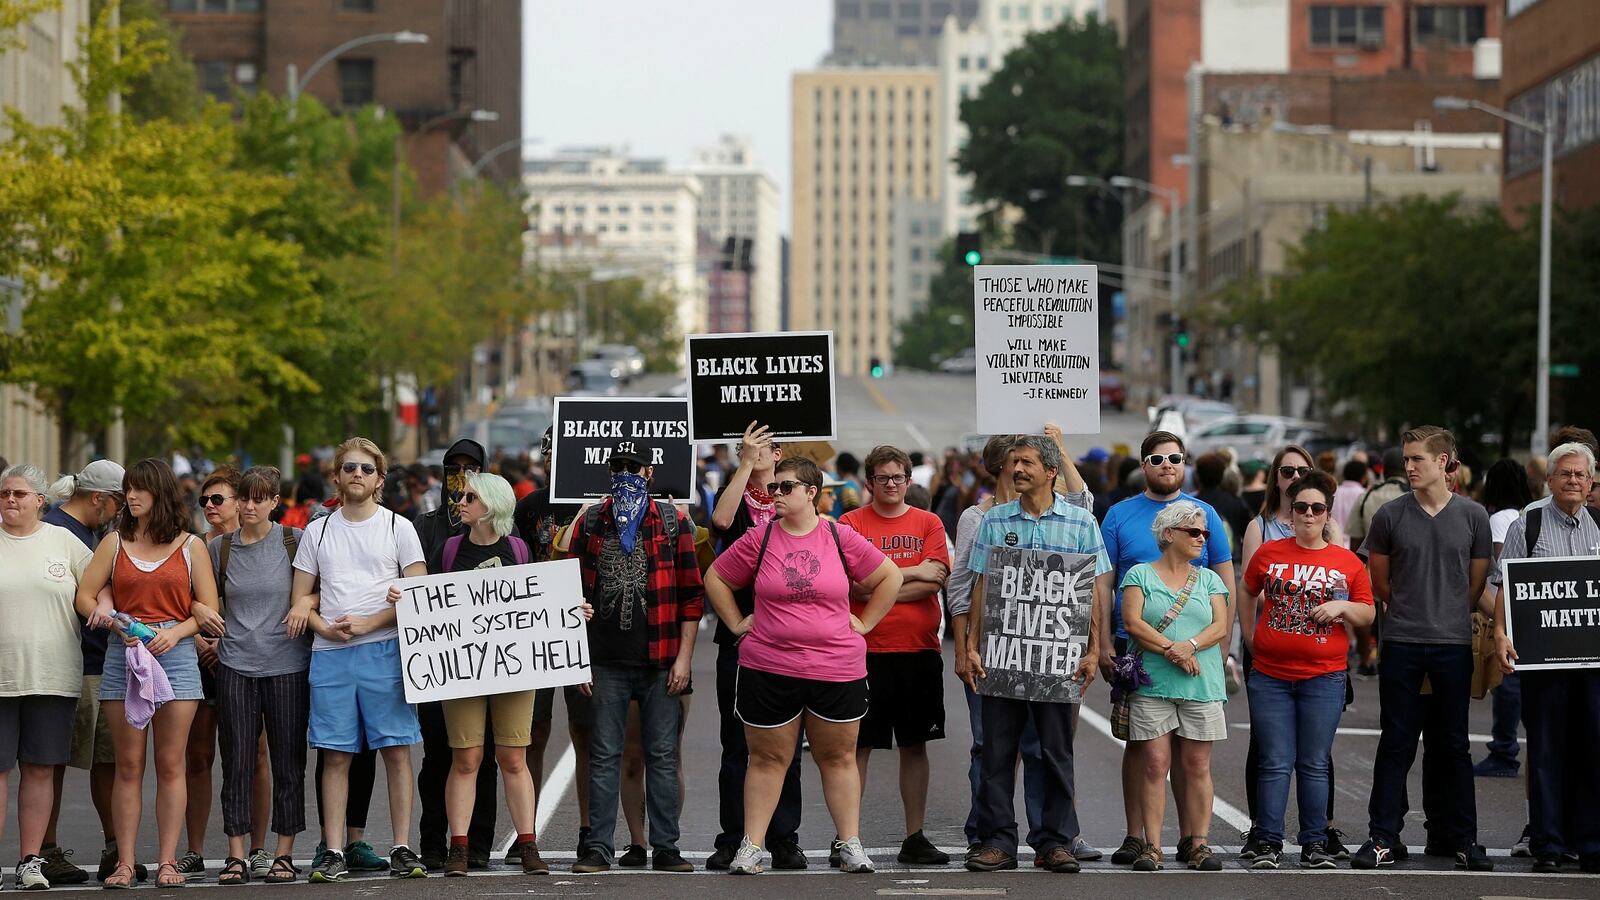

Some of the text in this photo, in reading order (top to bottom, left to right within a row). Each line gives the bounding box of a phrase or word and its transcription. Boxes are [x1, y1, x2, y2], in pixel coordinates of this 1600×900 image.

[979, 278, 1089, 294] THOSE WHO MAKE
[983, 298, 1093, 313] PEACEFUL REVOLUTION
[1008, 314, 1064, 329] IMPOSSIBLE
[1007, 339, 1067, 352] WILL MAKE
[696, 355, 824, 376] BLACK LIVES
[986, 354, 1090, 370] VIOLENT REVOLUTION
[1001, 371, 1064, 385] INEVITABLE
[720, 384, 802, 404] MATTER
[1045, 388, 1089, 400] KENNEDY
[563, 420, 687, 438] BLACK LIVES
[584, 447, 664, 465] MAR
[1266, 563, 1342, 584] IT WAS
[403, 575, 545, 615] THE WHOLE
[1001, 565, 1082, 605] BLACK
[1514, 580, 1600, 601] BLACK L
[404, 606, 582, 646] DAMN SYSTEM IS
[1002, 601, 1072, 640] LIVES
[1540, 608, 1600, 628] MATT
[985, 634, 1082, 675] MATTER
[406, 640, 591, 691] GUILTY AS HELL
